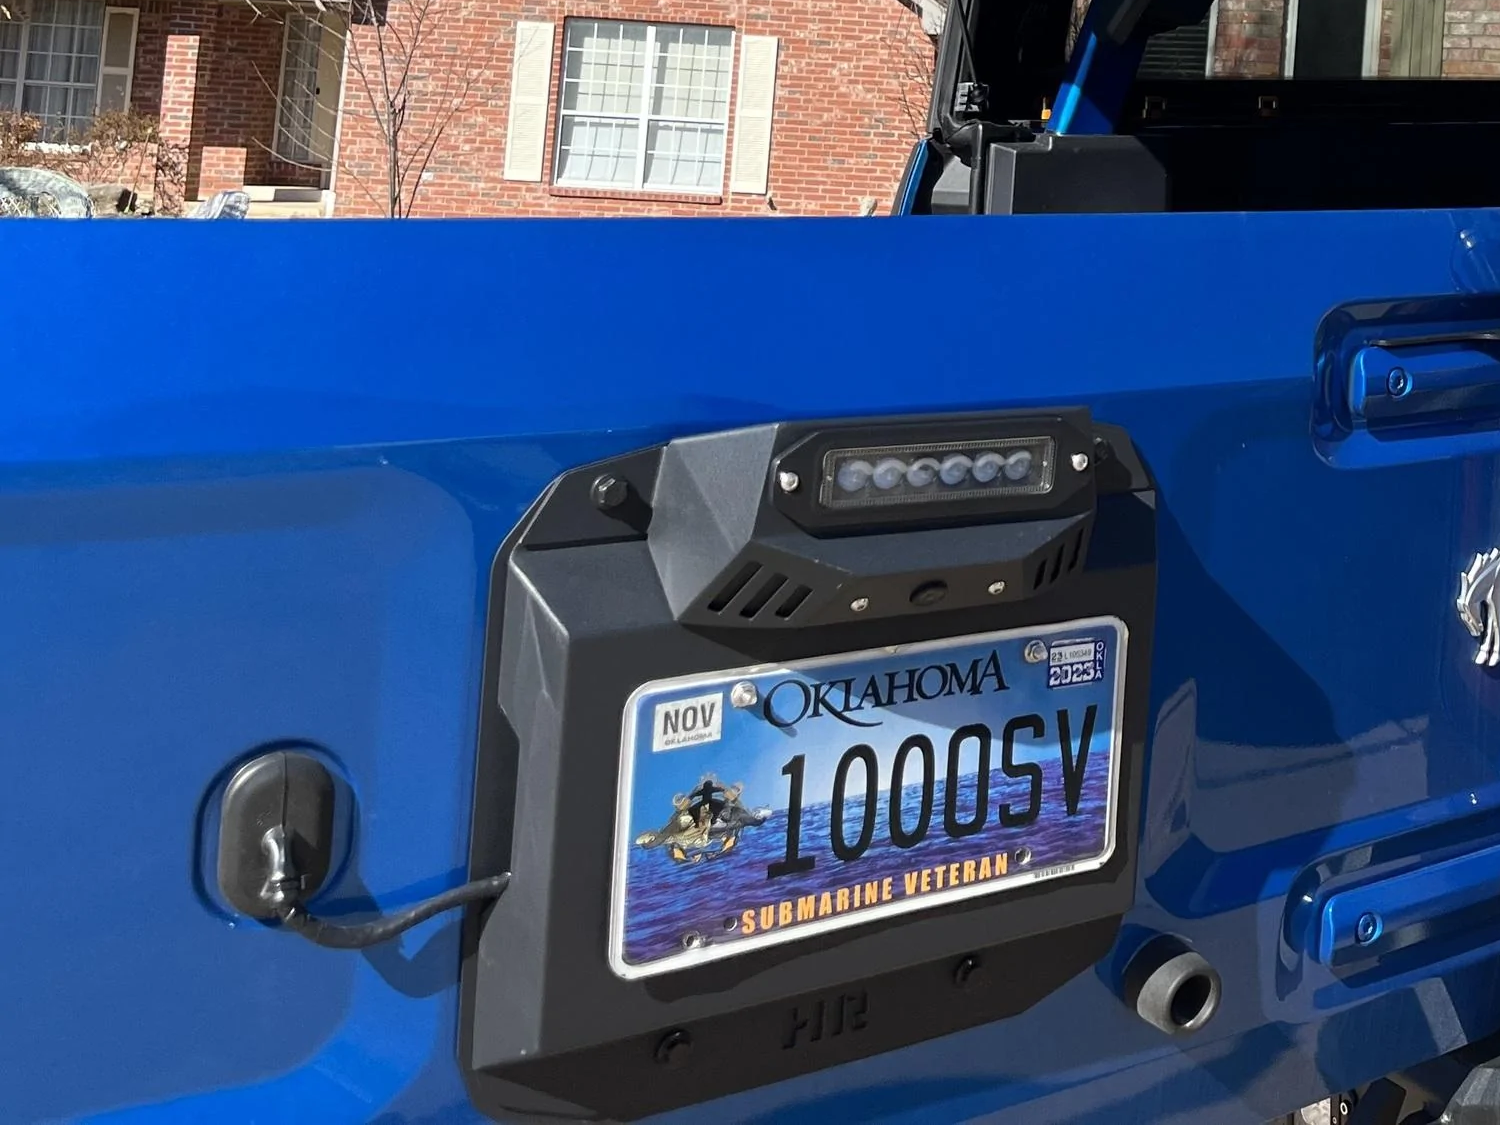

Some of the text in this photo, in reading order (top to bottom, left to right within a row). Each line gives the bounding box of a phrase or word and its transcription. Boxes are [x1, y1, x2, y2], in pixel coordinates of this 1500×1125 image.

[763, 650, 1010, 728] OKLAHOMA
[1049, 661, 1095, 686] 2023
[663, 702, 716, 736] NOV
[664, 731, 713, 746] OKLAHOMA
[741, 851, 1009, 935] SUBMARINE VETERAN
